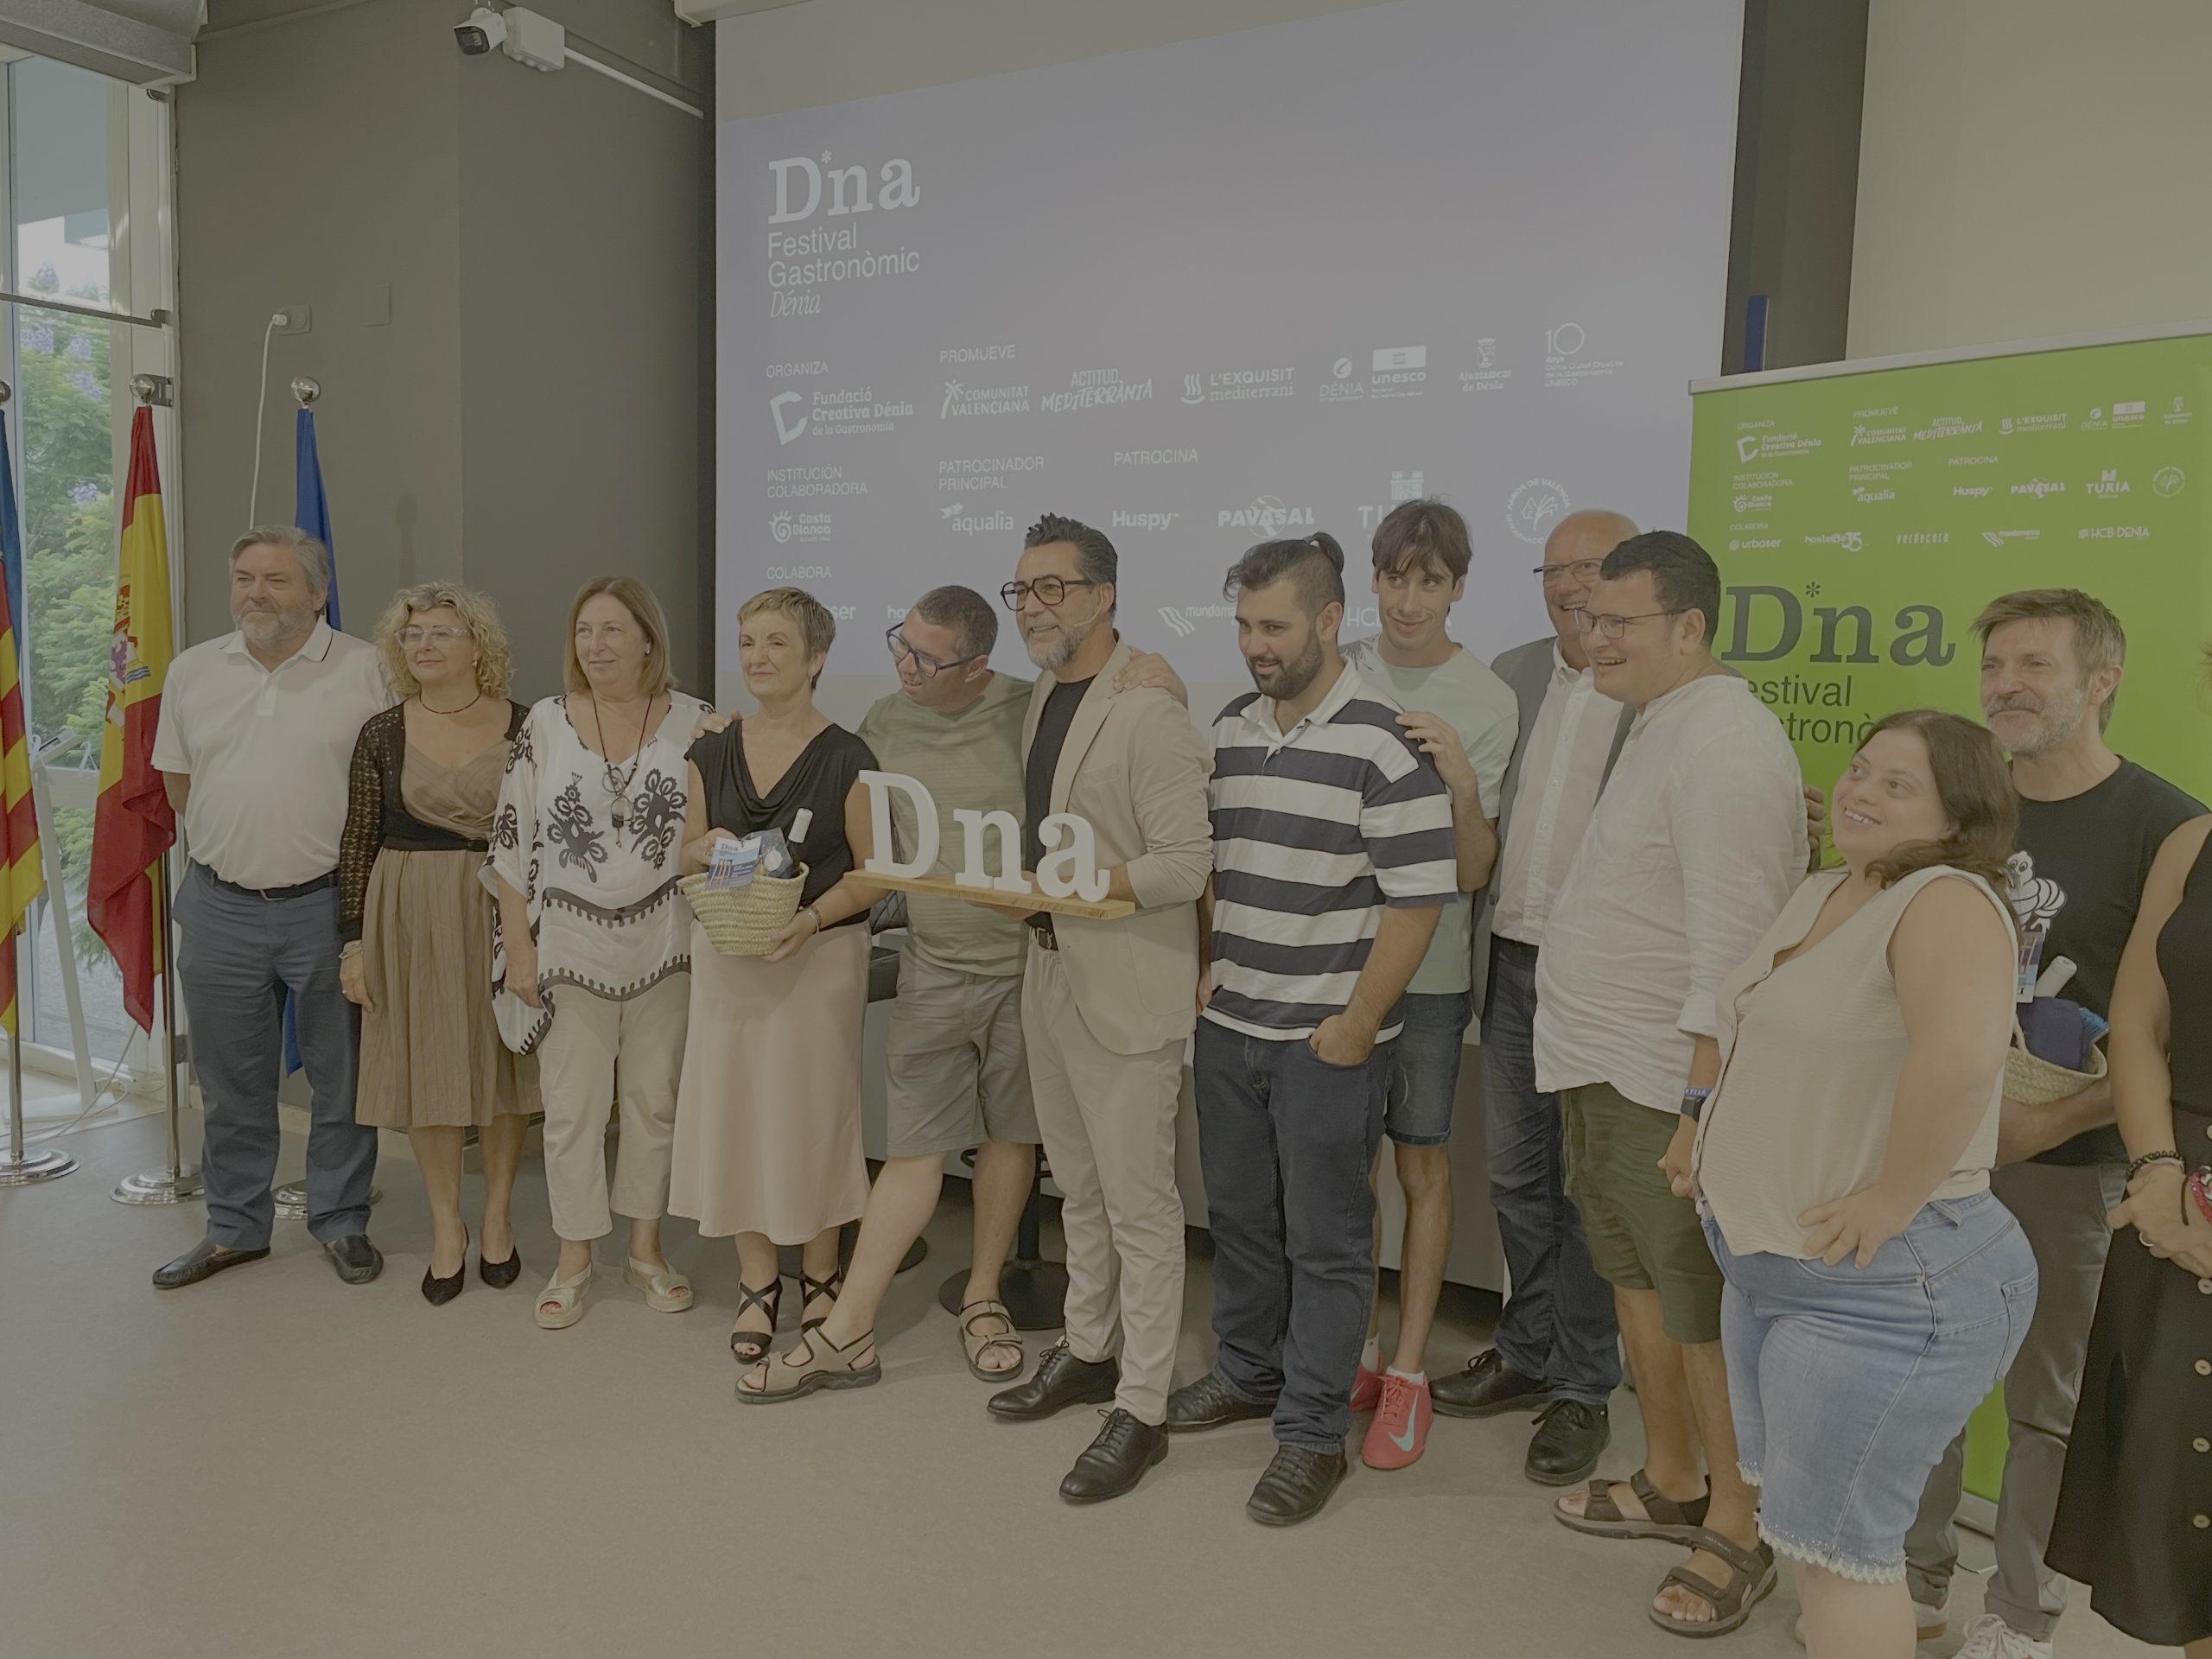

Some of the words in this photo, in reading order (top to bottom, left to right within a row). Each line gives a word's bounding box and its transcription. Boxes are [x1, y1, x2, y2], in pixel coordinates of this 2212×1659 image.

[767, 222, 857, 258] Festival
[767, 246, 920, 288] Gastronòmic
[769, 289, 822, 318] Dénia
[939, 344, 1017, 364] PROMUEVE
[766, 360, 830, 378] ORGANIZA
[1071, 368, 1119, 387] ACTITUD
[1211, 367, 1295, 386] L'EXQUISIT
[1371, 371, 1427, 385] unesco
[812, 385, 872, 405] Fundació
[965, 385, 1030, 402] COMUNITAT
[1210, 382, 1294, 401] mediterrani
[1319, 381, 1364, 397] DÉNIA
[812, 404, 870, 422] Creativa
[874, 401, 913, 417] Dénia
[951, 398, 1031, 416] VALENCIANA
[1853, 406, 1900, 418] PROMUEVE
[938, 455, 1045, 474] PATROCINADOR
[1114, 448, 1199, 467] PATROCINA
[1948, 455, 1999, 467] PATROCINA
[767, 463, 842, 482] INSTITUCIÓN
[767, 480, 868, 499] COLABORADORA
[938, 475, 1008, 491] PRINCIPAL
[2085, 480, 2131, 495] TURIA
[1857, 489, 1895, 504] aqualia
[798, 512, 832, 524] Costa
[951, 512, 1014, 537] aqualia
[1112, 509, 1172, 531] Huspy
[1217, 506, 1316, 528] PAVASAL
[1741, 538, 1782, 549] urbaser
[766, 565, 833, 581] COLABORA
[1748, 674, 1853, 707] estival
[859, 769, 1111, 903] Dna
